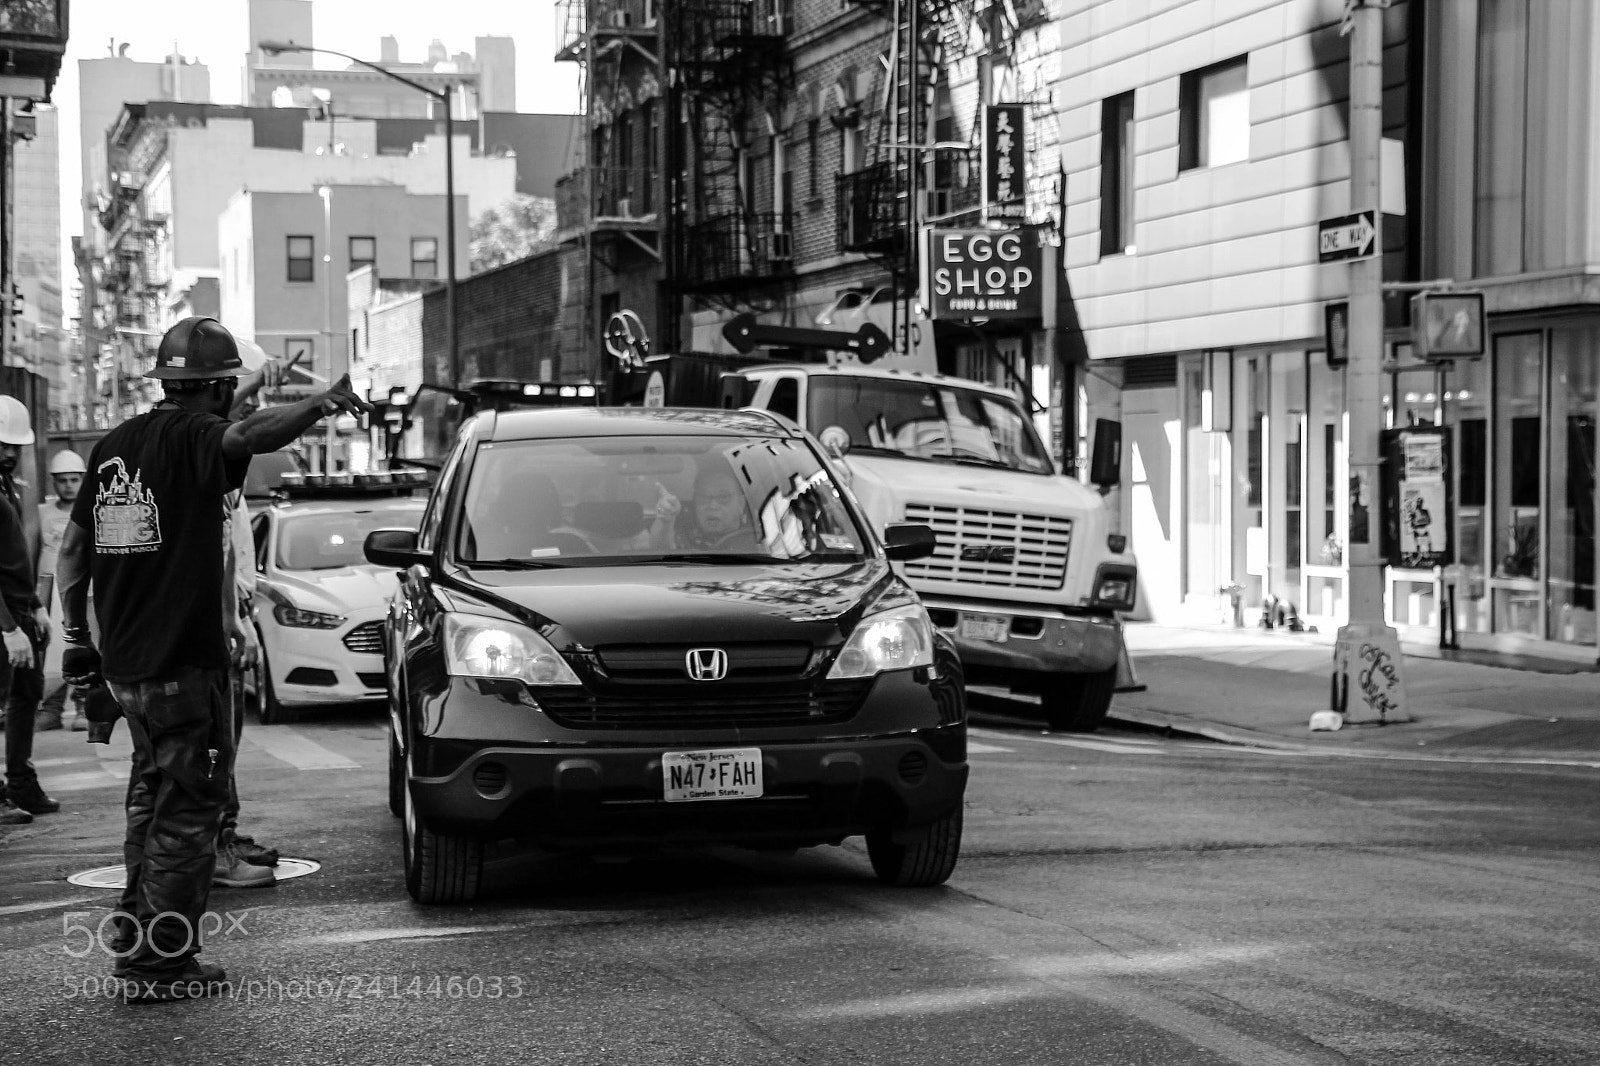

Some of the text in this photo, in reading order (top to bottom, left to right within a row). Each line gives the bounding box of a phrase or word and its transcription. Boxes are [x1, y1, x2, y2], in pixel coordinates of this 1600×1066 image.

[943, 234, 1022, 262] EGG
[1322, 225, 1367, 250] ONE WAY
[935, 266, 1033, 295] SHOP
[708, 752, 735, 762] Jersey
[689, 789, 739, 798] Garden State
